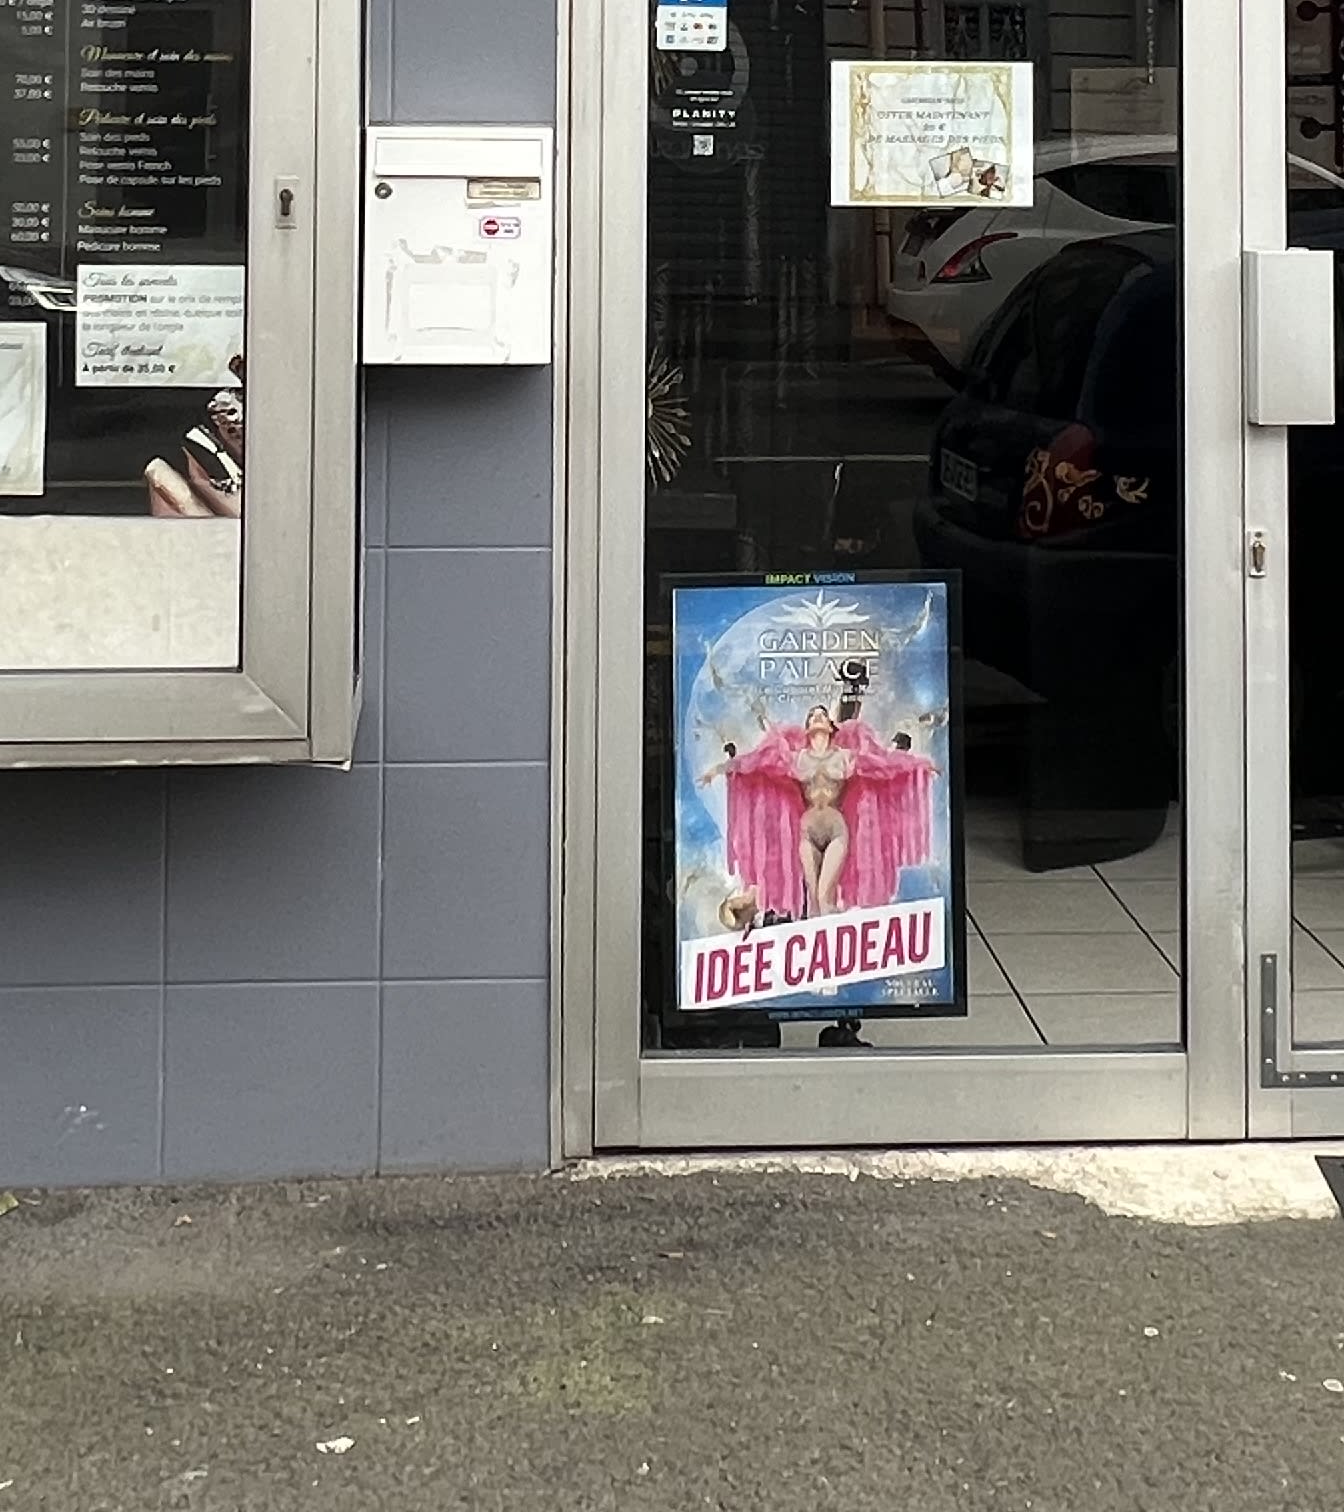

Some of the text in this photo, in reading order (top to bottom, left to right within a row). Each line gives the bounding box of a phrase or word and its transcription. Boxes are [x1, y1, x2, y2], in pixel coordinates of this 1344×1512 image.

[672, 108, 736, 119] PLANITY
[765, 572, 856, 585] IMPACT VISION
[759, 628, 880, 651] GARDEN
[759, 657, 880, 680] PALACE
[694, 912, 932, 1003] IDÉE CADEAU
